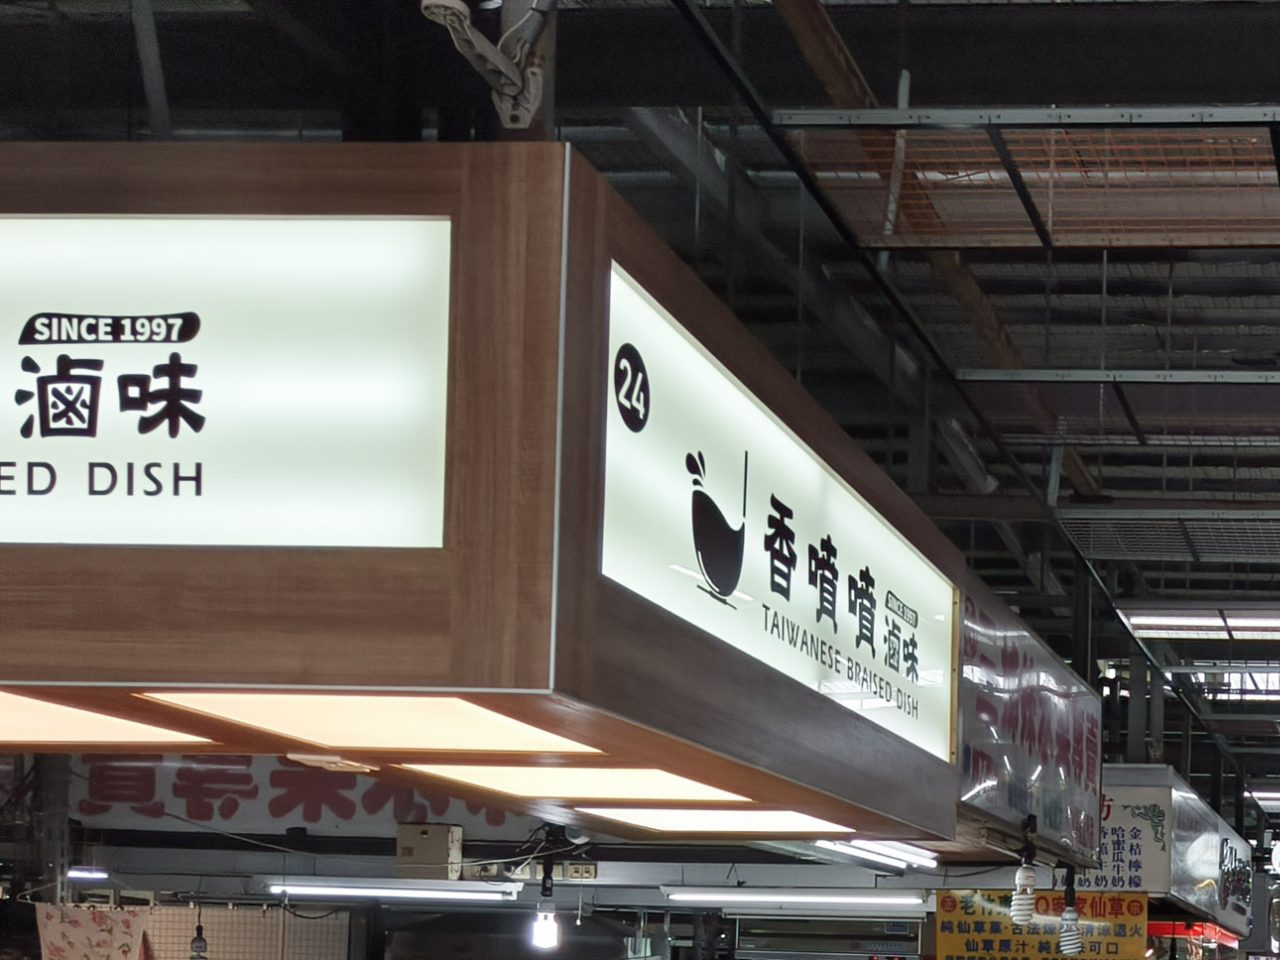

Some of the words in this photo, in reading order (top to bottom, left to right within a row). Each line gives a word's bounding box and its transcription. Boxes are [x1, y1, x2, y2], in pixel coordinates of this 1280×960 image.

[34, 317, 113, 341] SINCE
[120, 317, 183, 341] 1997
[15, 352, 206, 439] 滷味
[618, 357, 646, 420] 24
[88, 462, 203, 496] DISH
[763, 493, 877, 660] 香噴噴
[761, 603, 841, 674] TAIWANESE
[847, 656, 892, 703] BRAISED
[896, 687, 919, 720] DISH
[884, 615, 919, 683] 滷味
